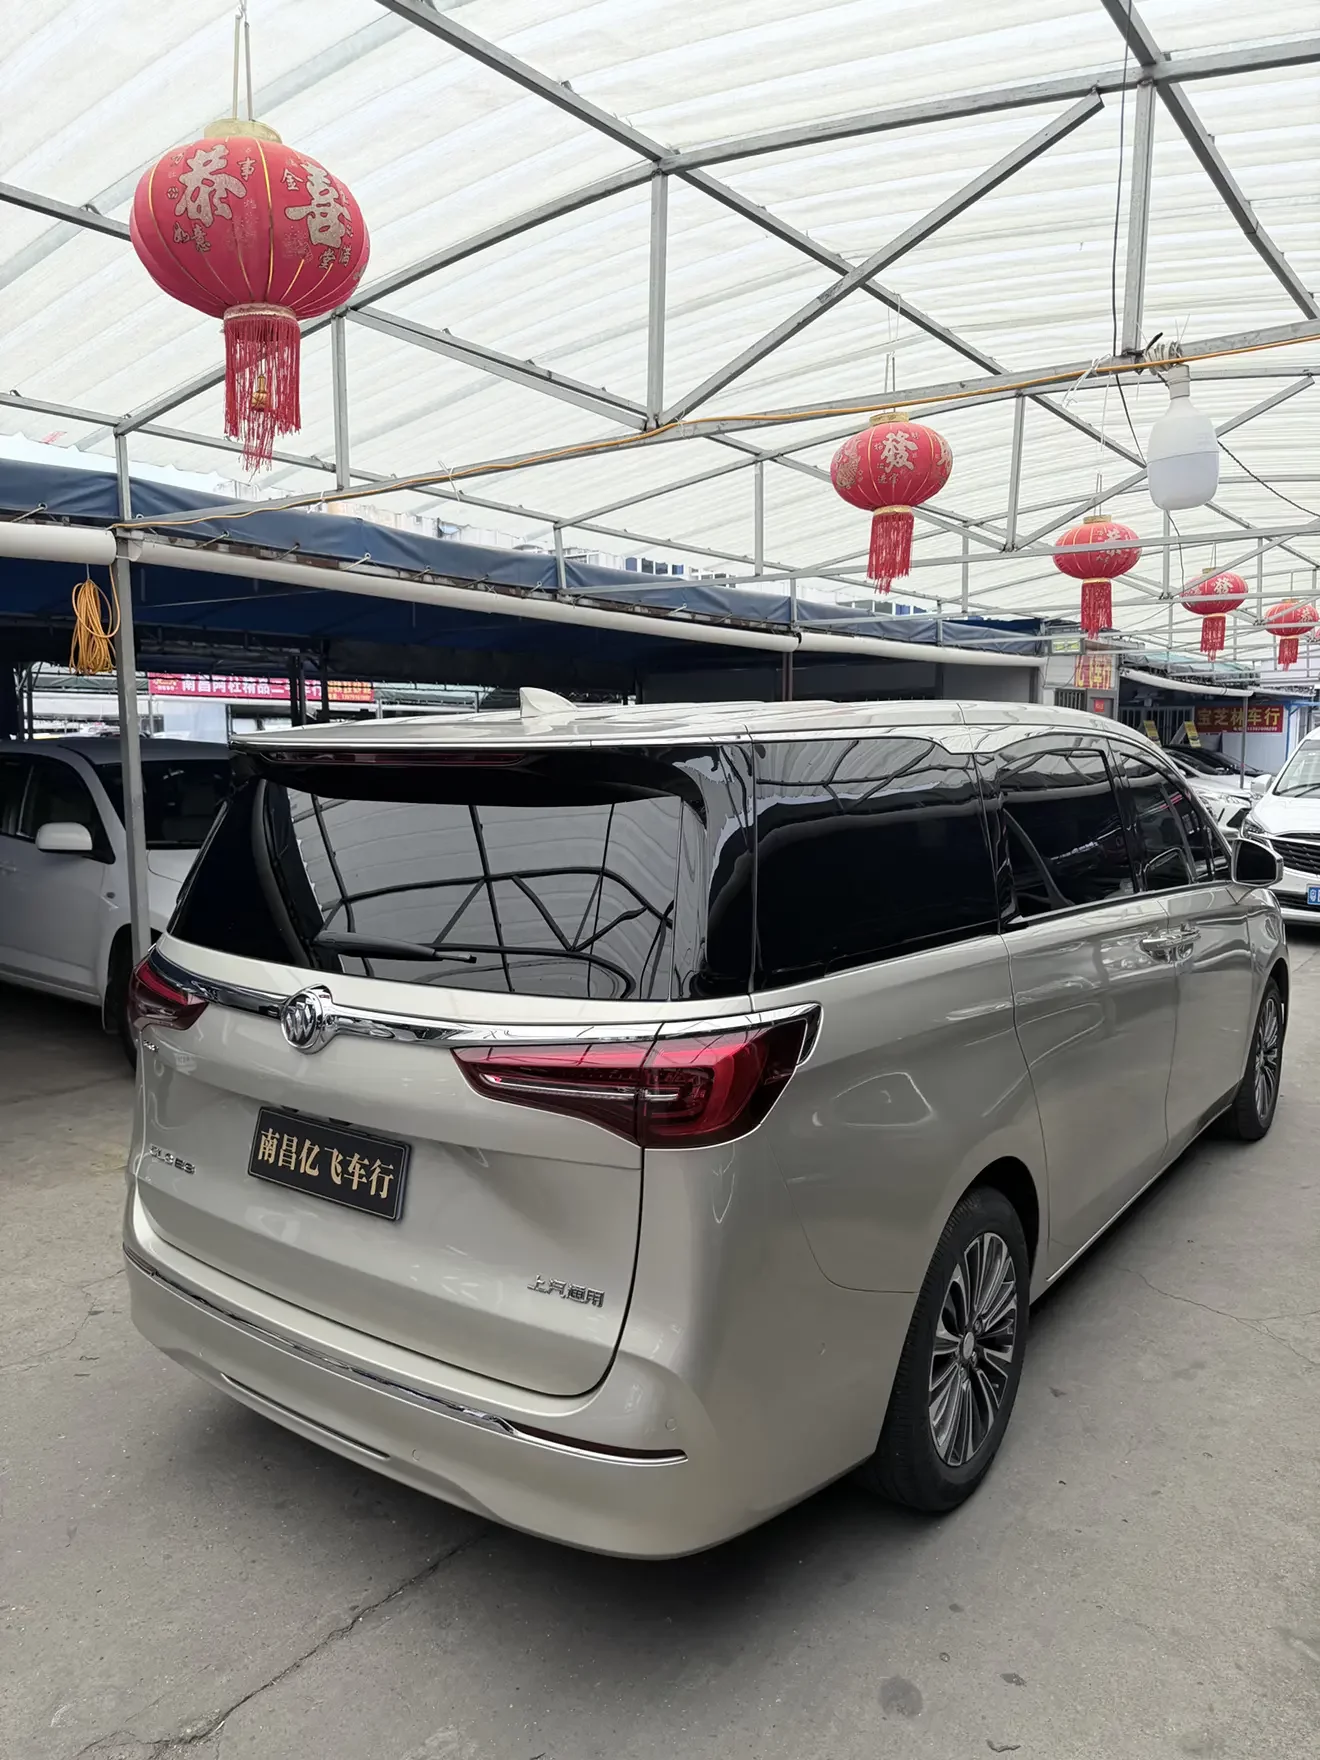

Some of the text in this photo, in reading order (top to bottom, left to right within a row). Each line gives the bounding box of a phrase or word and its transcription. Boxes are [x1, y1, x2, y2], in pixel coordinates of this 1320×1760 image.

[1197, 707, 1280, 726] 宝芝林车行
[257, 1128, 395, 1200] 南昌亿飞车行
[527, 1274, 605, 1308] 上汽通用
